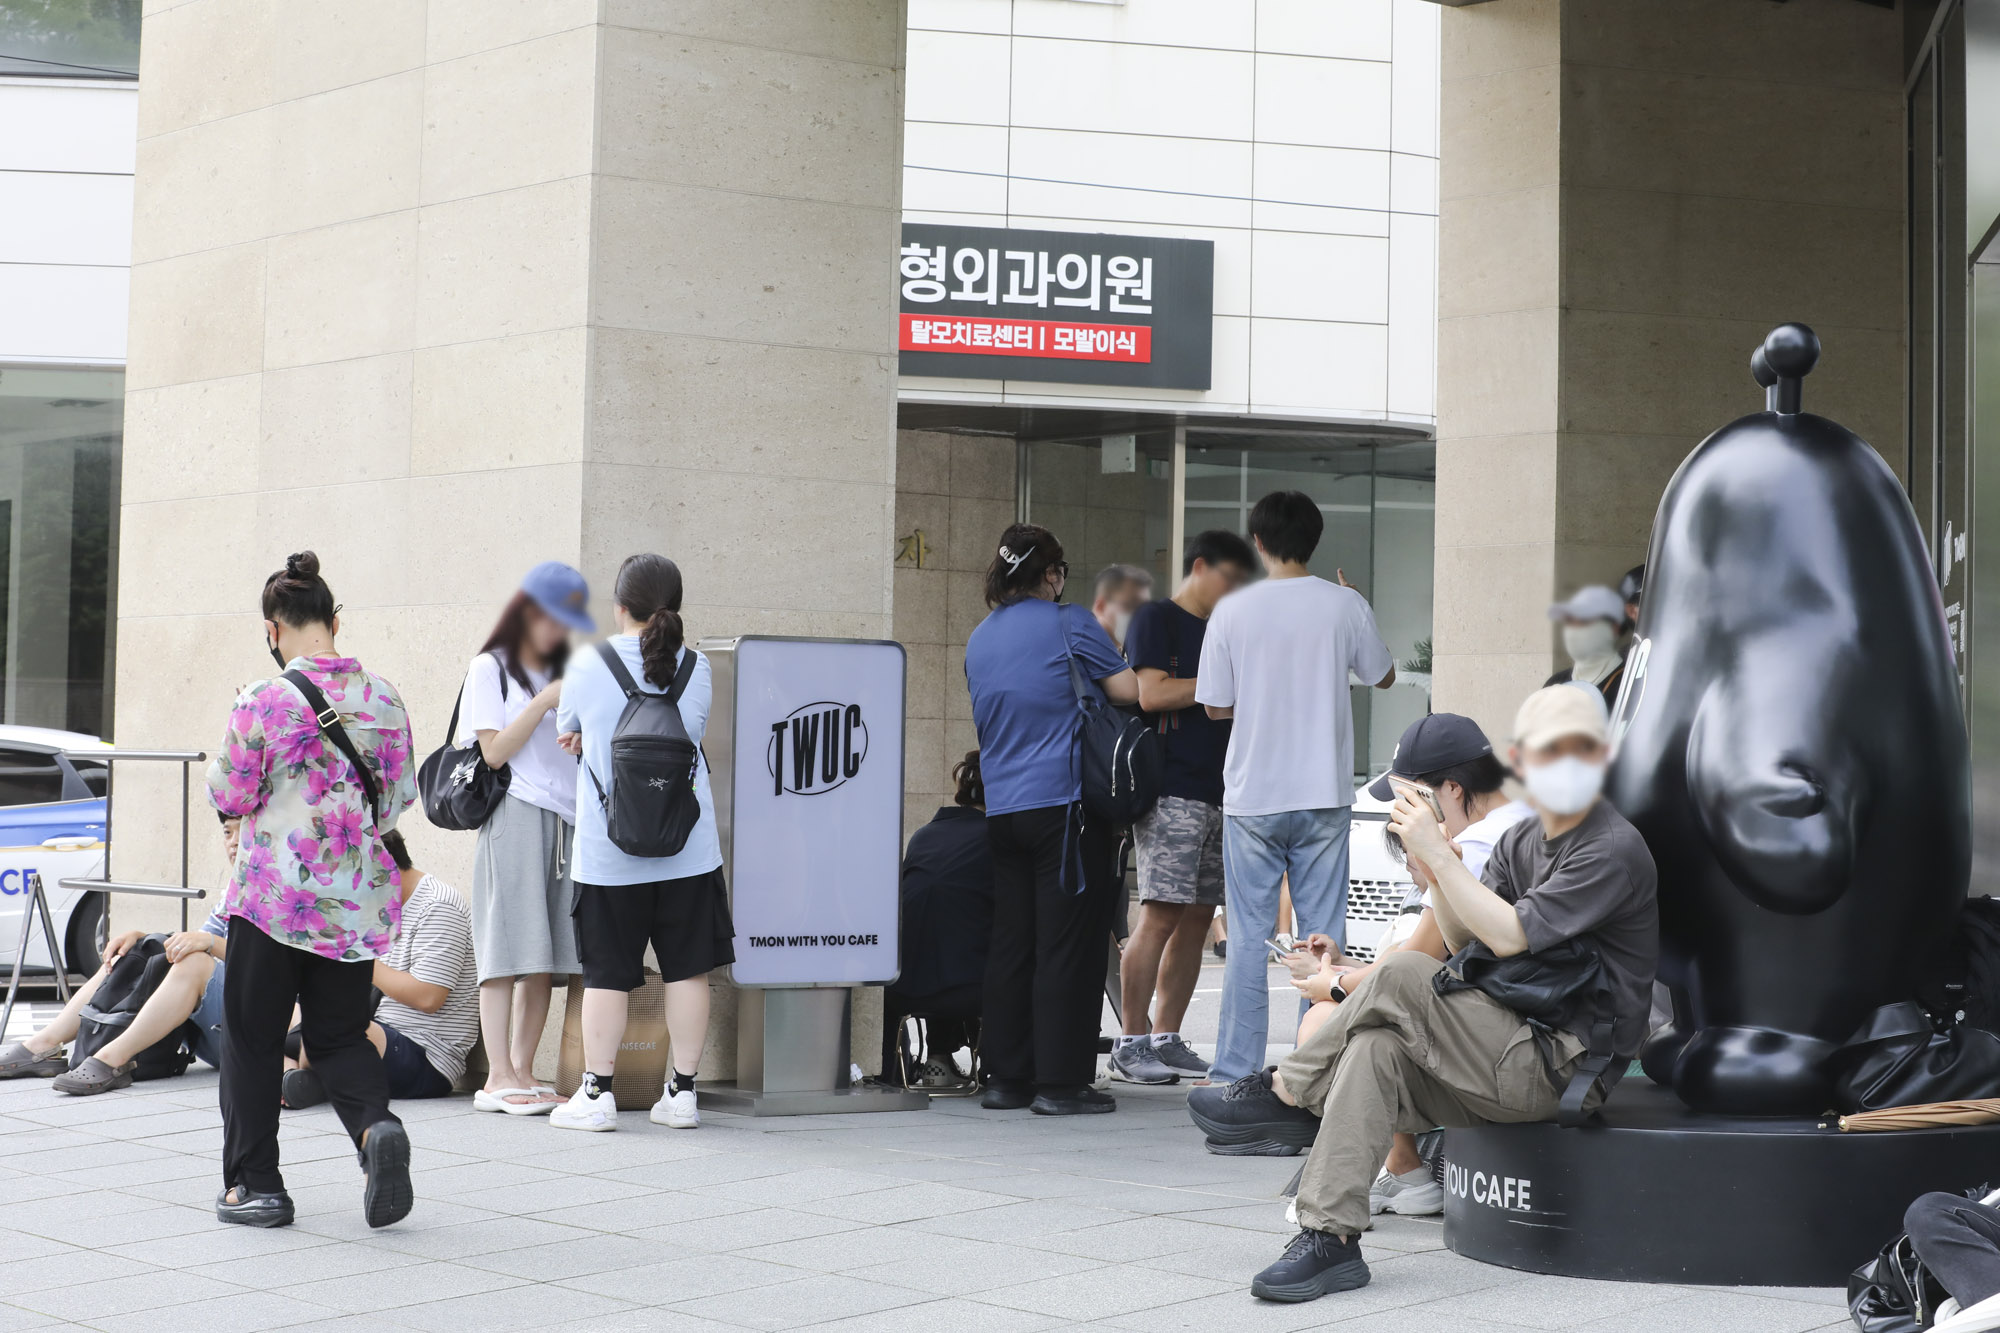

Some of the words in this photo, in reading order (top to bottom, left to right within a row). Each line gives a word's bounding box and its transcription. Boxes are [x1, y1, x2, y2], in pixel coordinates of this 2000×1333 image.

[899, 242, 1153, 315] 형외과의원
[910, 319, 1033, 350] 탈모치료센터
[1053, 326, 1136, 356] 모발이식
[771, 703, 861, 796] TWUC
[749, 936, 785, 948] TMON
[787, 935, 818, 947] WITH
[821, 935, 846, 946] YOU
[848, 934, 878, 945] CAFE
[1472, 1171, 1531, 1210] CAFE
